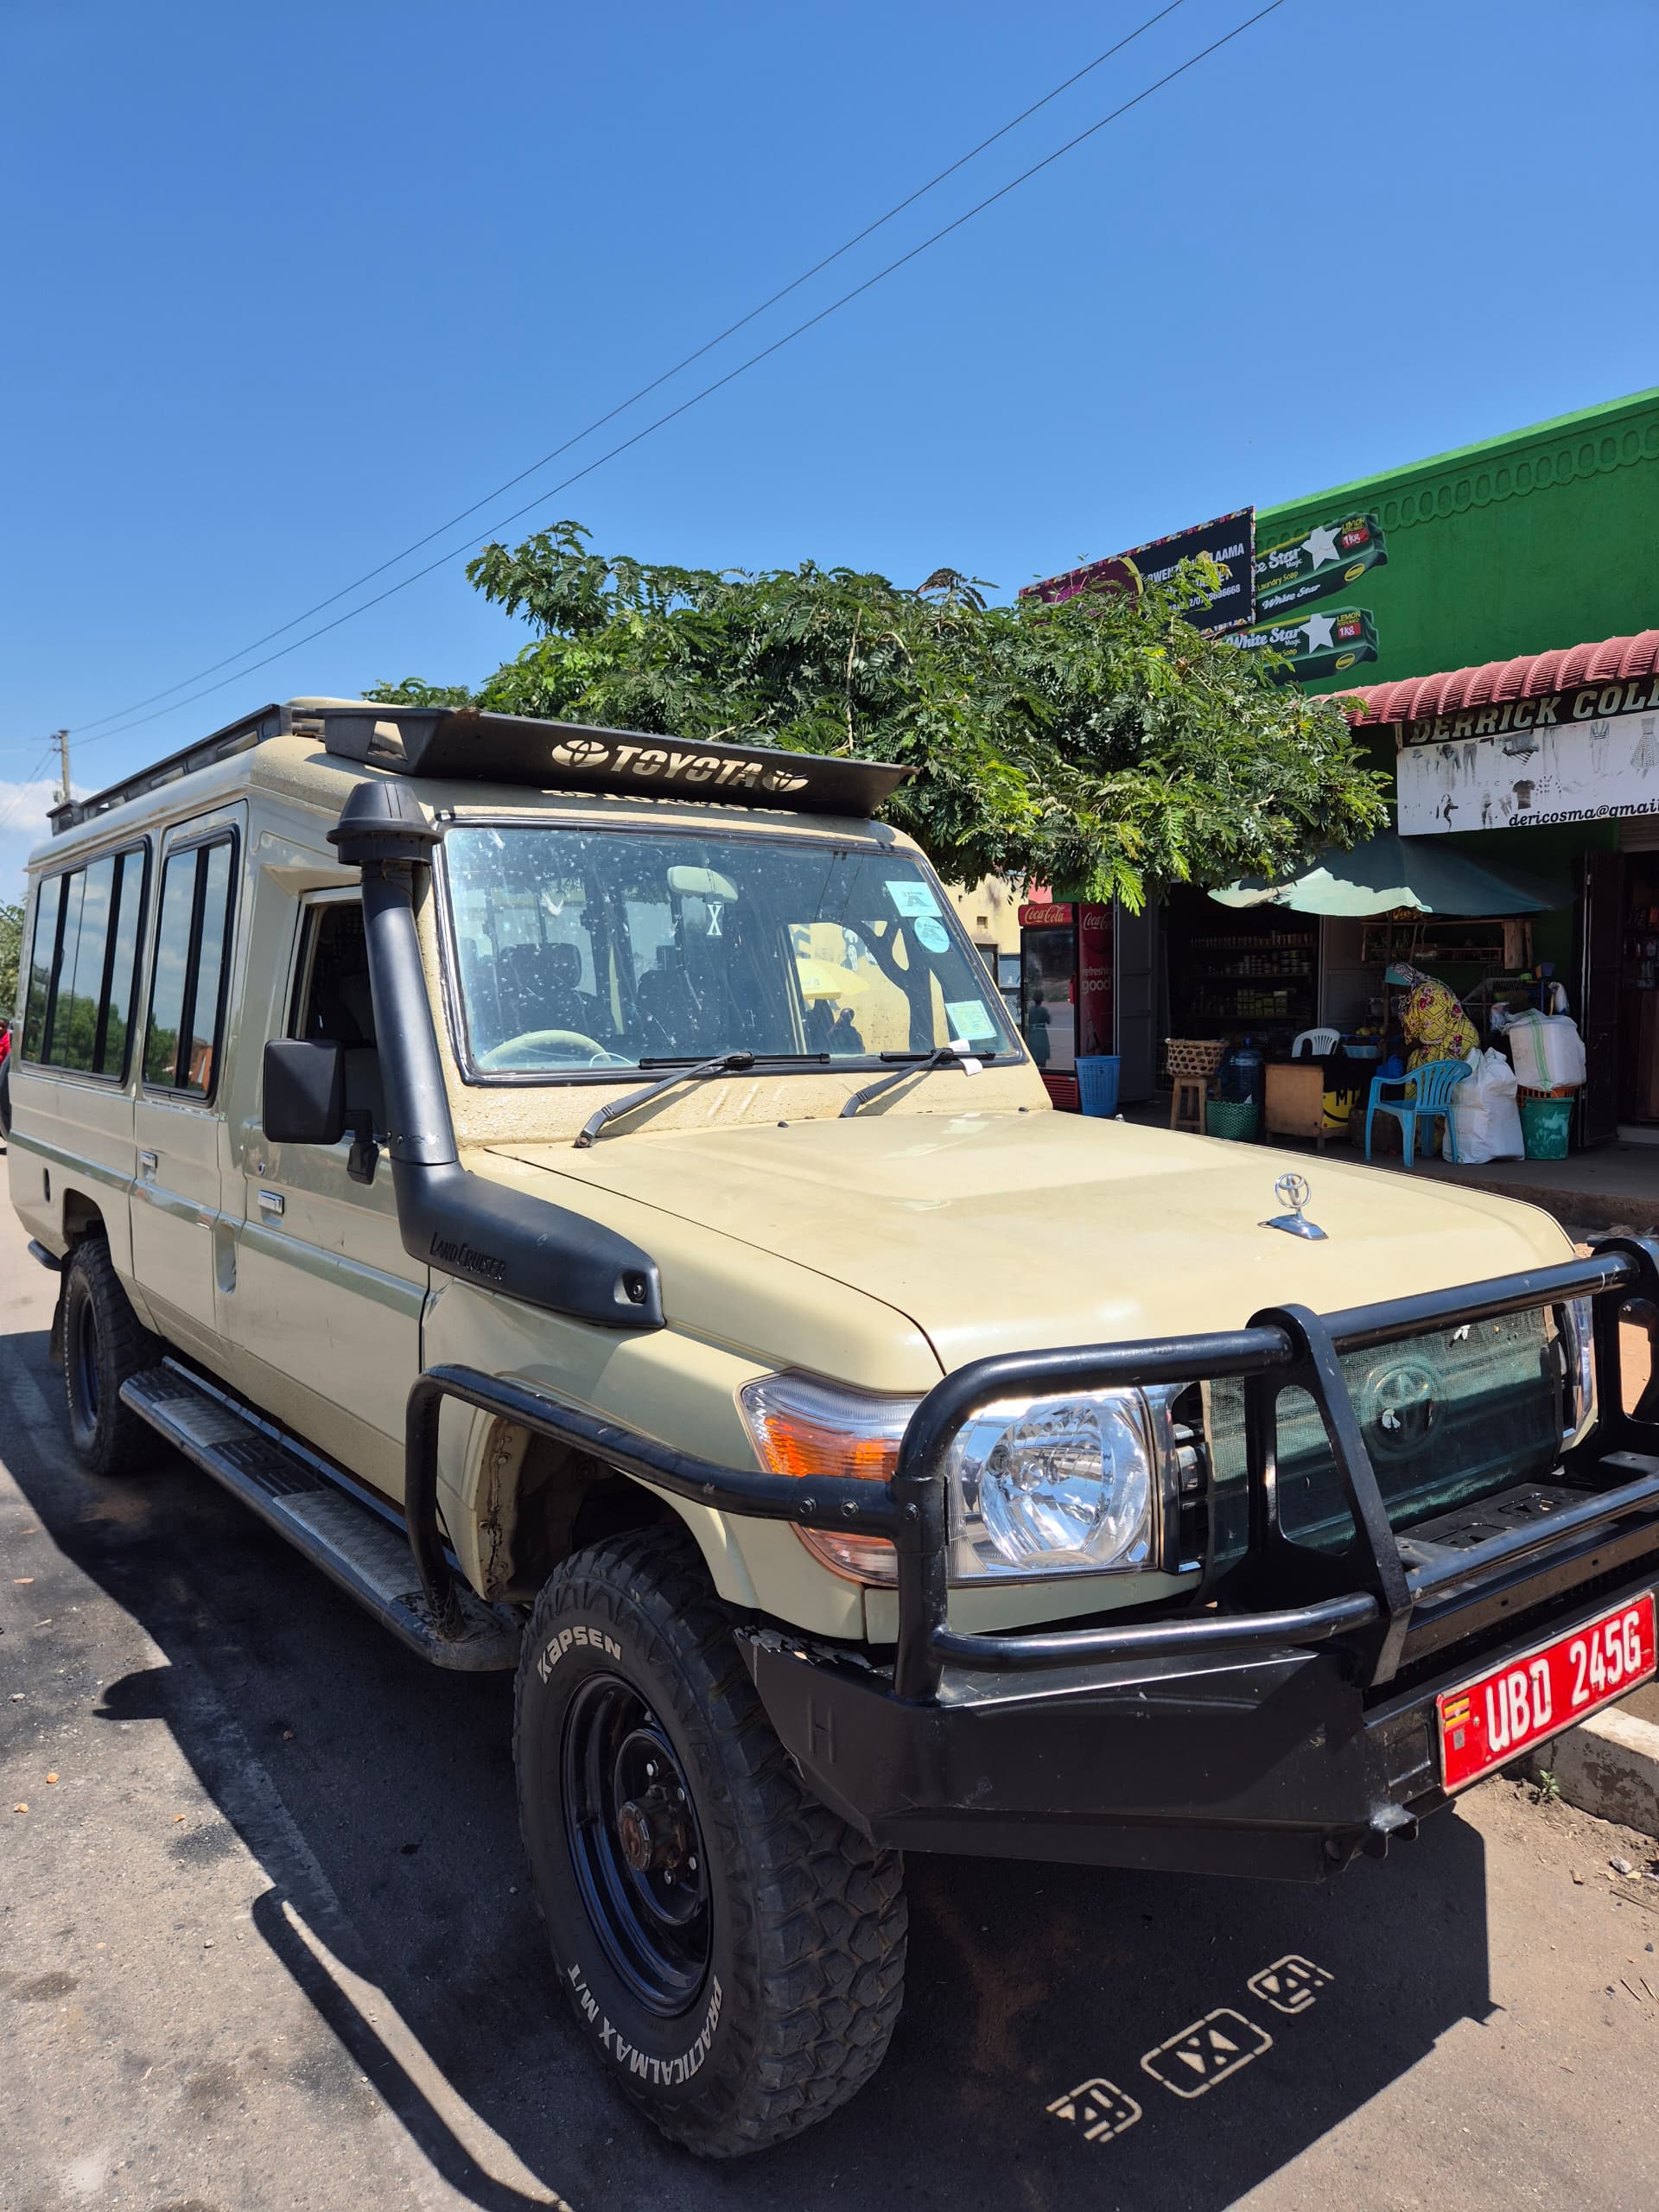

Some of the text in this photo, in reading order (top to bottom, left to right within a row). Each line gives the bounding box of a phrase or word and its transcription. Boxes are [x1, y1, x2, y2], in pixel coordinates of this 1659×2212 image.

[1268, 548, 1301, 569] Star
[1257, 571, 1298, 591] Laundry Soap
[1262, 584, 1321, 610] White Star
[1337, 611, 1361, 623] LEMON
[1270, 627, 1301, 644] Star
[1282, 648, 1298, 658] Soap
[1410, 697, 1561, 743] DERRICK
[610, 745, 764, 788] TOYOTA
[1082, 976, 1112, 995] good
[1485, 1610, 1642, 1753] UBD 245G
[567, 1963, 601, 2024] M/T
